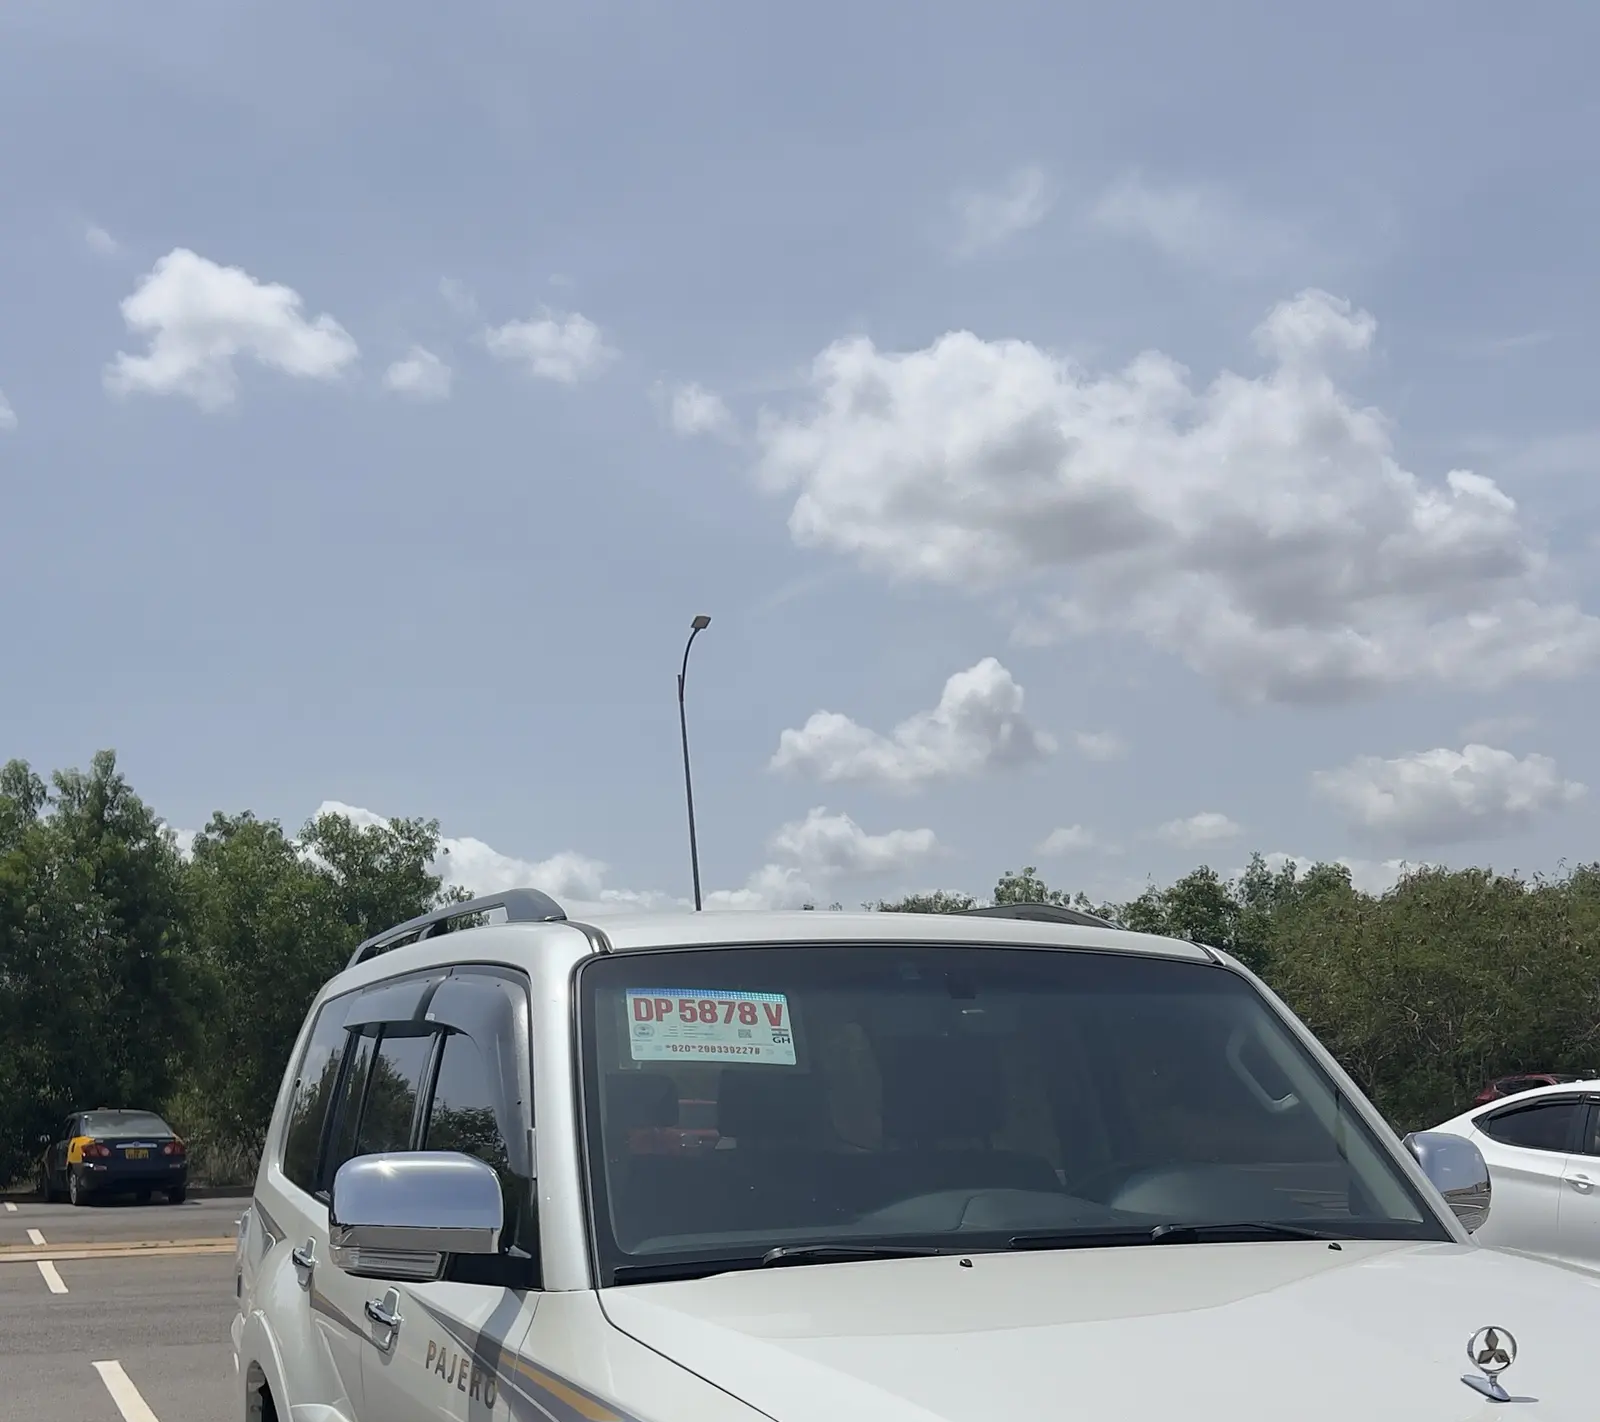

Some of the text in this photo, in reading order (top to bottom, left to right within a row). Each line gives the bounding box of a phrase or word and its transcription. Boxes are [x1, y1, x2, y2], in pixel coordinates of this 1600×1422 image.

[633, 998, 783, 1027] DP 5878 V
[772, 1036, 791, 1044] GH
[425, 1340, 498, 1409] PAJERO
